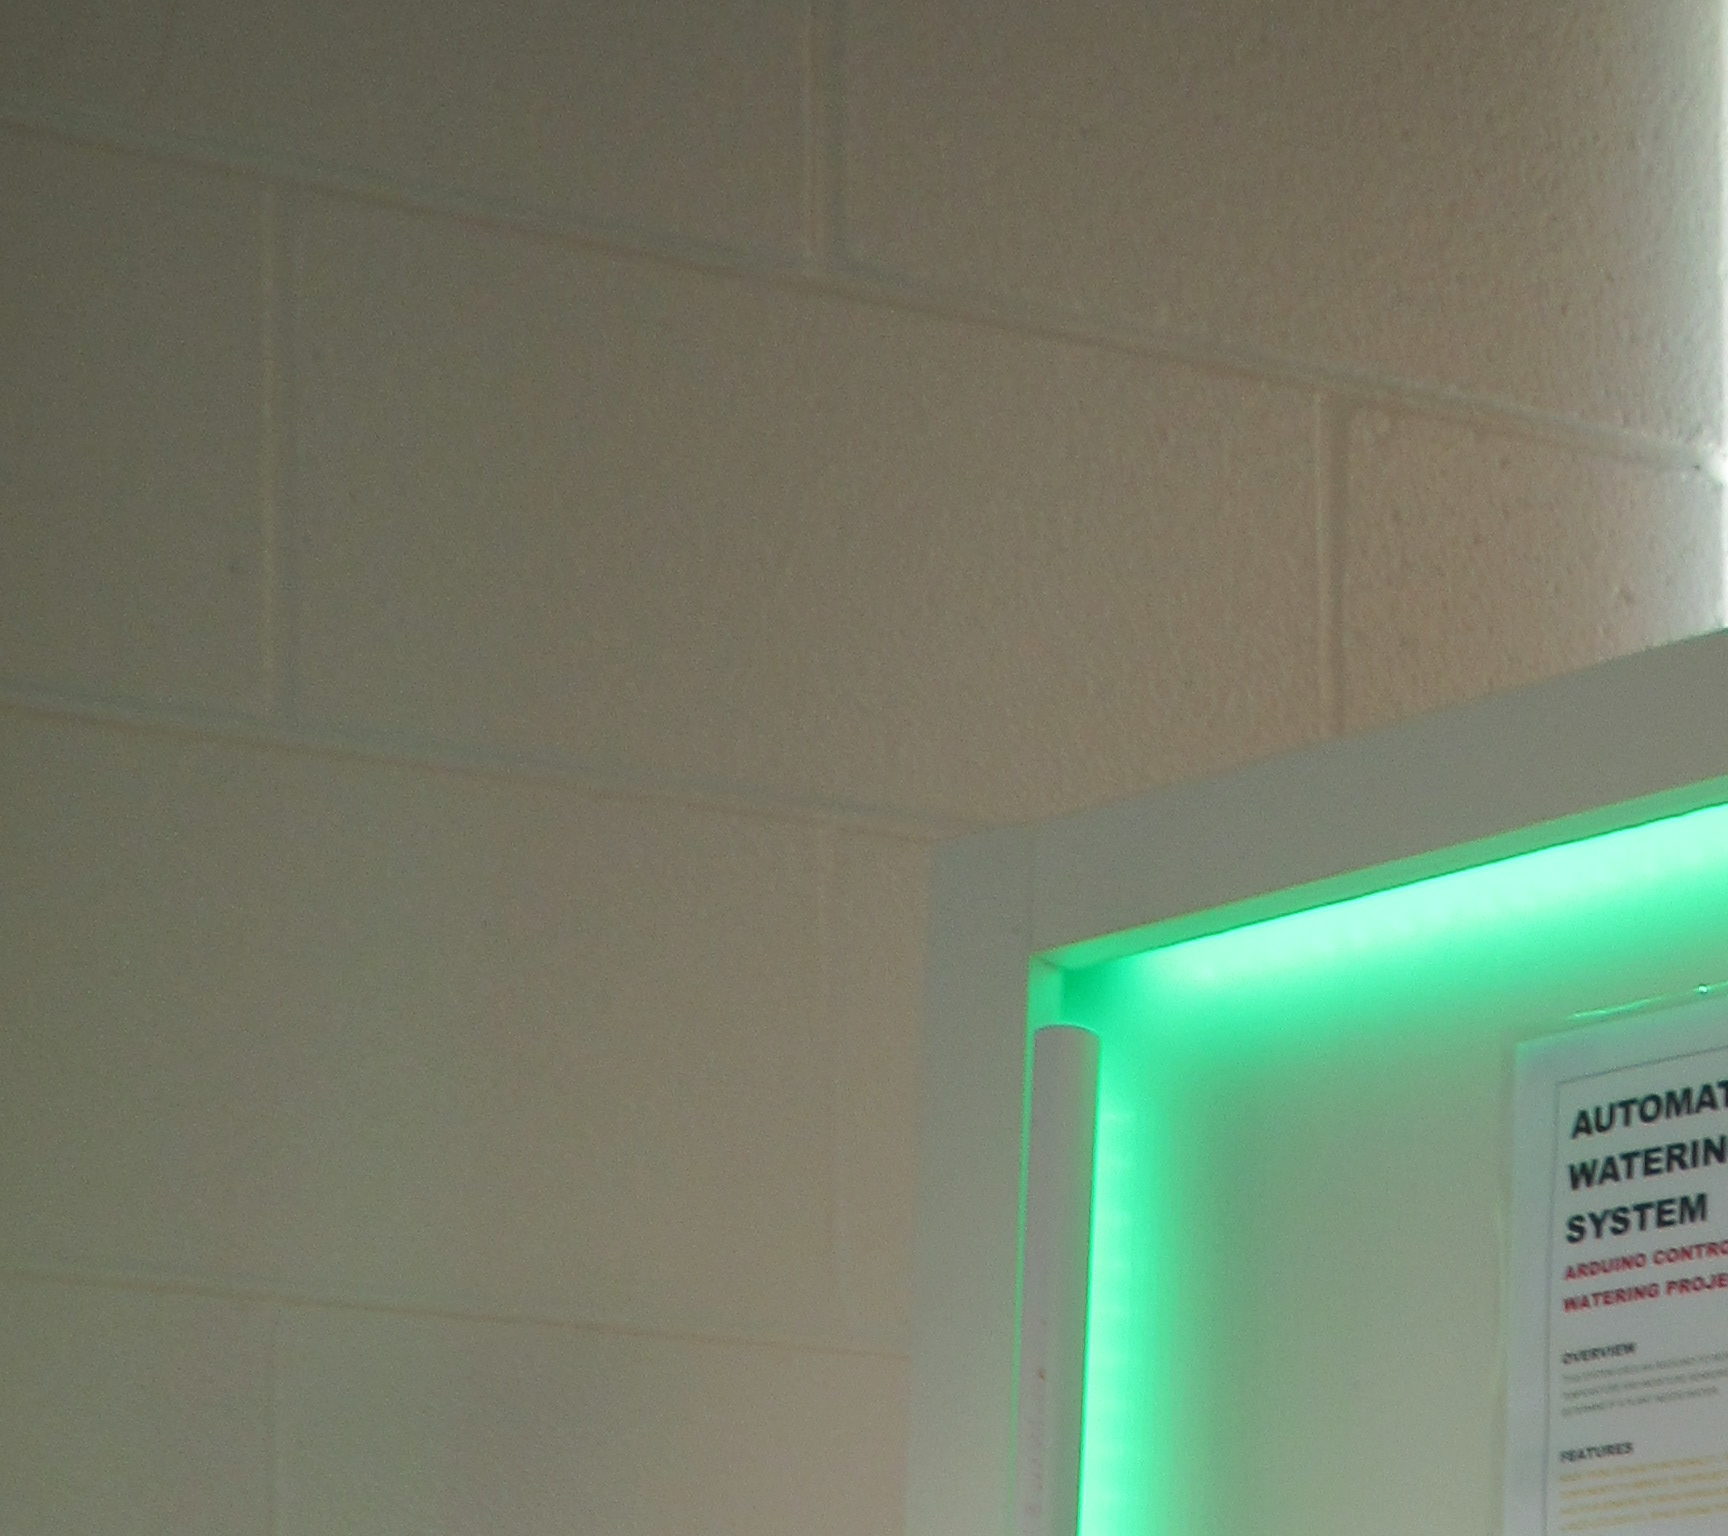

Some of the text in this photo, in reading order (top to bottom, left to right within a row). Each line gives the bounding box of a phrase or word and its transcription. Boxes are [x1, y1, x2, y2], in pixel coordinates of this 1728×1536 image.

[1565, 1192, 1707, 1243] SYSTEM
[1564, 1253, 1644, 1282] ARDUINO
[1562, 1283, 1658, 1314] WATERING
[1561, 1341, 1636, 1364] OVERVIEW
[1558, 1441, 1634, 1463] FEATURES
